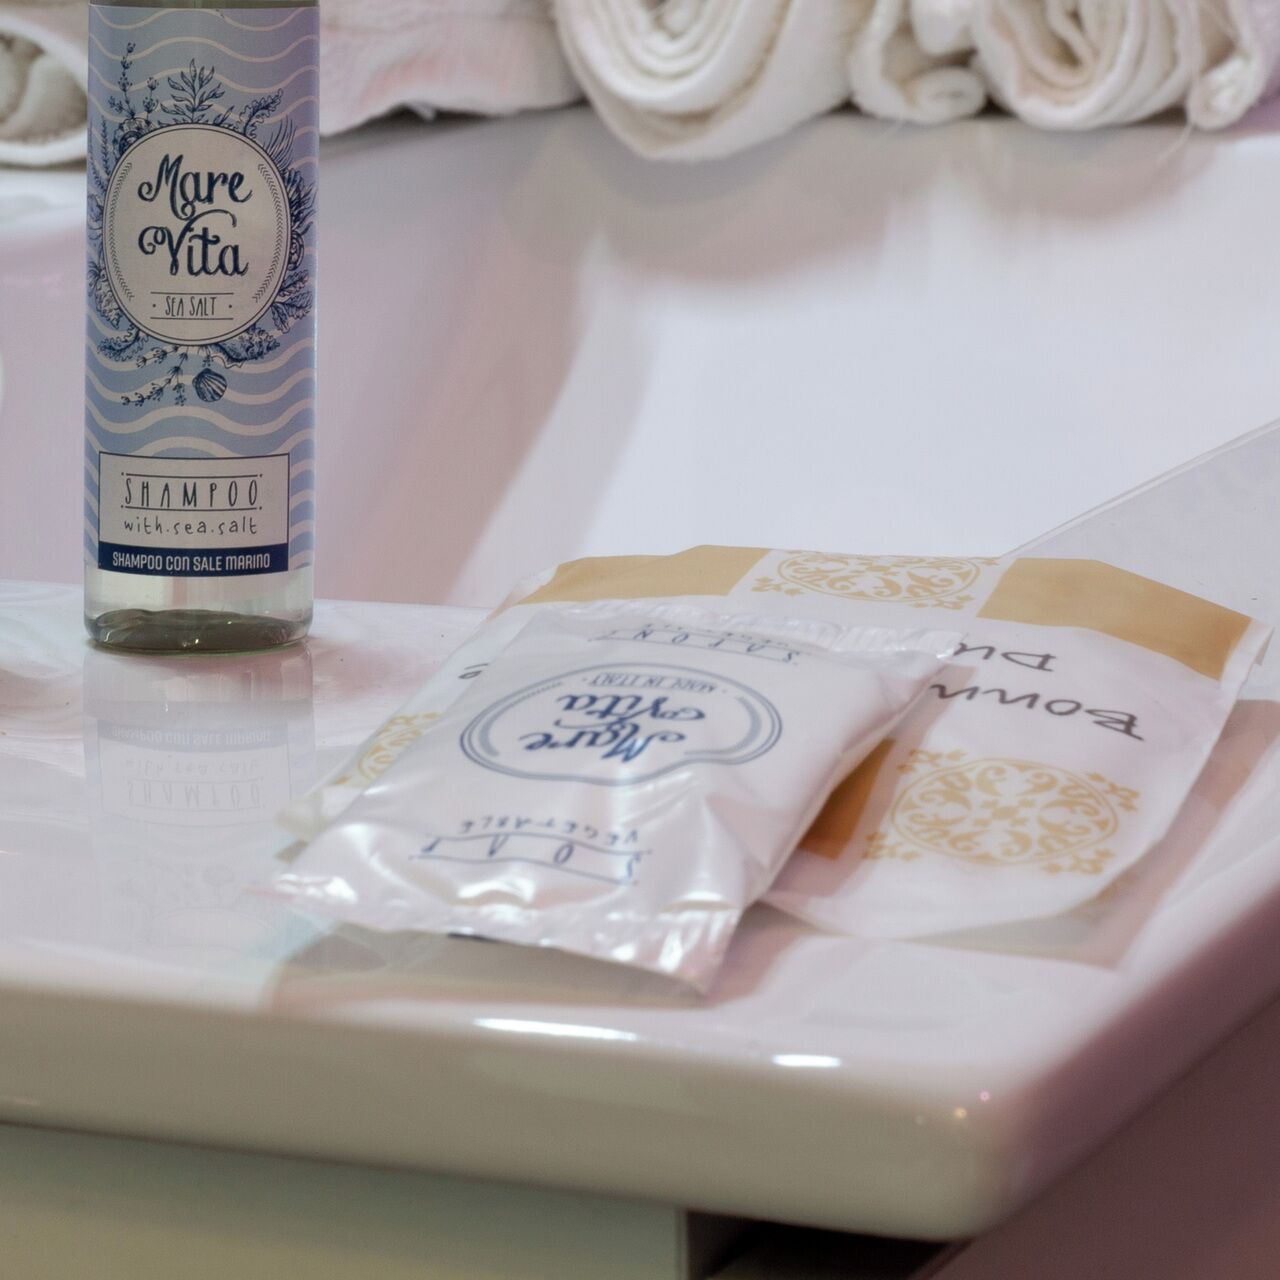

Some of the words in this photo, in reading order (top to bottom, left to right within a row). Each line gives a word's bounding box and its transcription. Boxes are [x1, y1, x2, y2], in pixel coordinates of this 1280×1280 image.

[137, 154, 253, 220] Mare
[138, 209, 249, 276] Vita
[165, 296, 184, 317] SEA
[189, 296, 217, 316] SALT
[125, 477, 258, 508] SHAMPOO
[112, 552, 162, 570] SHAMPOO
[193, 556, 222, 571] SALE
[953, 642, 1057, 672] Du
[554, 694, 707, 728] Vita
[929, 684, 1144, 741] Bonn
[518, 720, 687, 762] Mare
